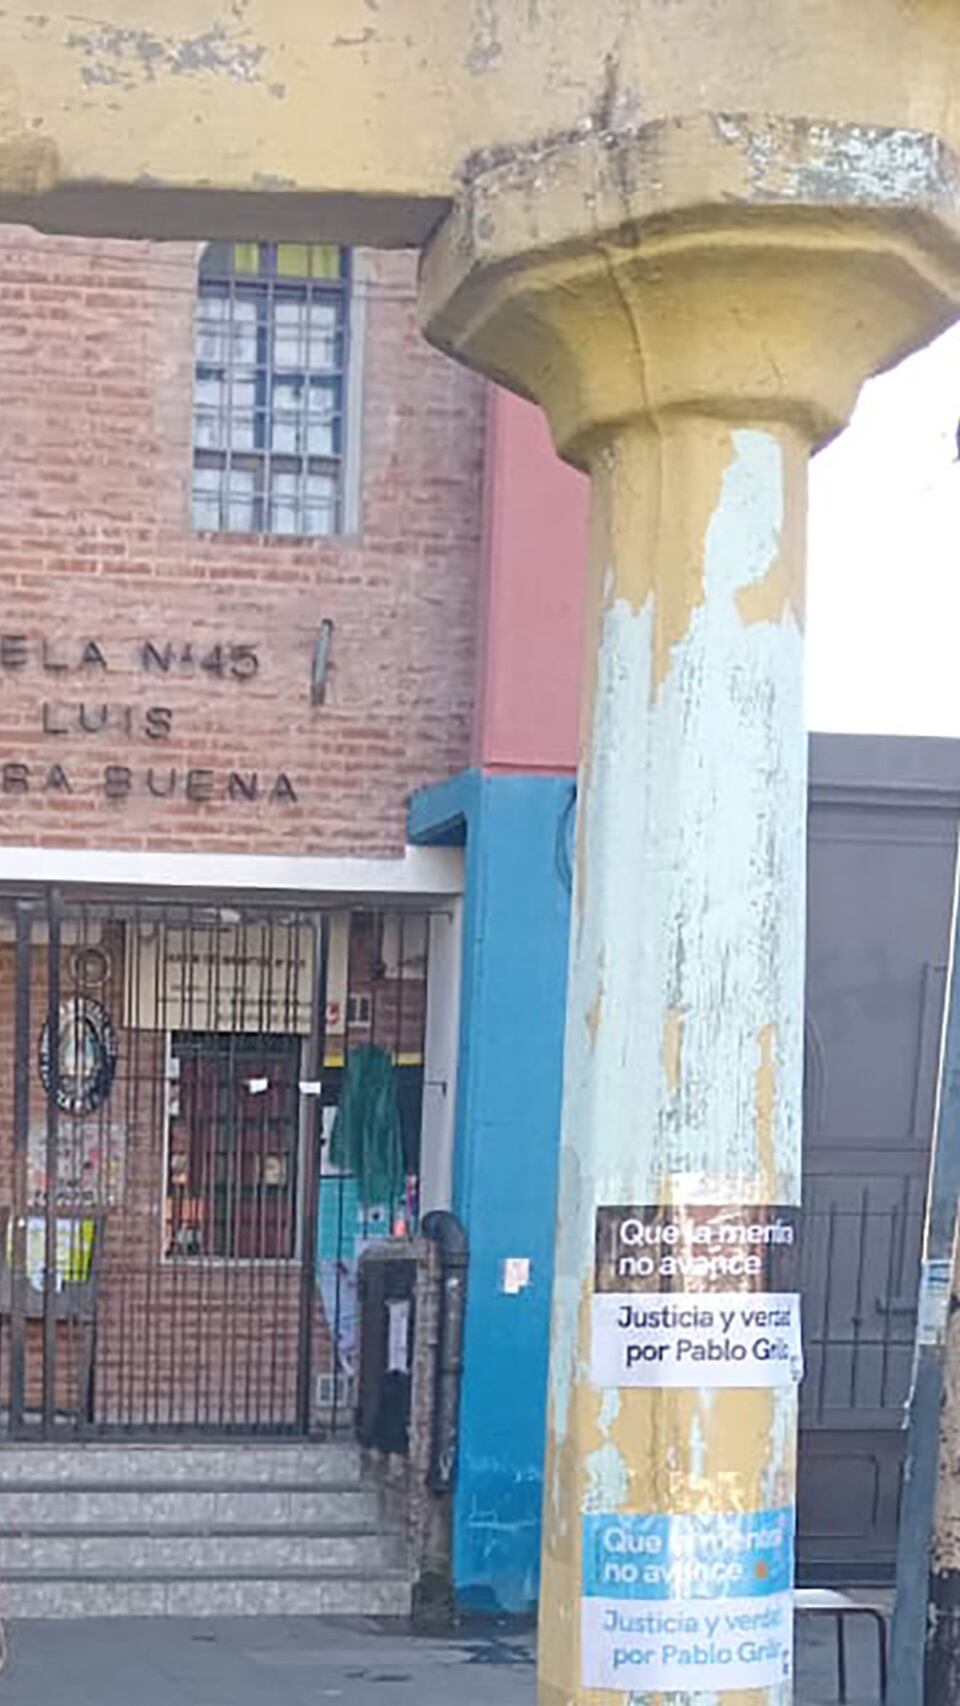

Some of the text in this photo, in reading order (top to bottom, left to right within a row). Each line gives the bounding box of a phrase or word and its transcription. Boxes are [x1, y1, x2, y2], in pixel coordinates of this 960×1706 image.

[42, 702, 173, 741] LUIS
[104, 764, 298, 803] BUENA
[620, 1219, 680, 1247] Que
[619, 1255, 761, 1276] no avance
[618, 1305, 714, 1328] Justicia
[720, 1310, 735, 1334] y
[627, 1344, 670, 1368] por
[676, 1338, 747, 1362] Pablo
[604, 1526, 662, 1553] Que
[603, 1562, 639, 1583] no
[603, 1609, 699, 1634] Justicia
[705, 1616, 719, 1638] y
[613, 1648, 655, 1671] por
[661, 1642, 733, 1665] Pablo
